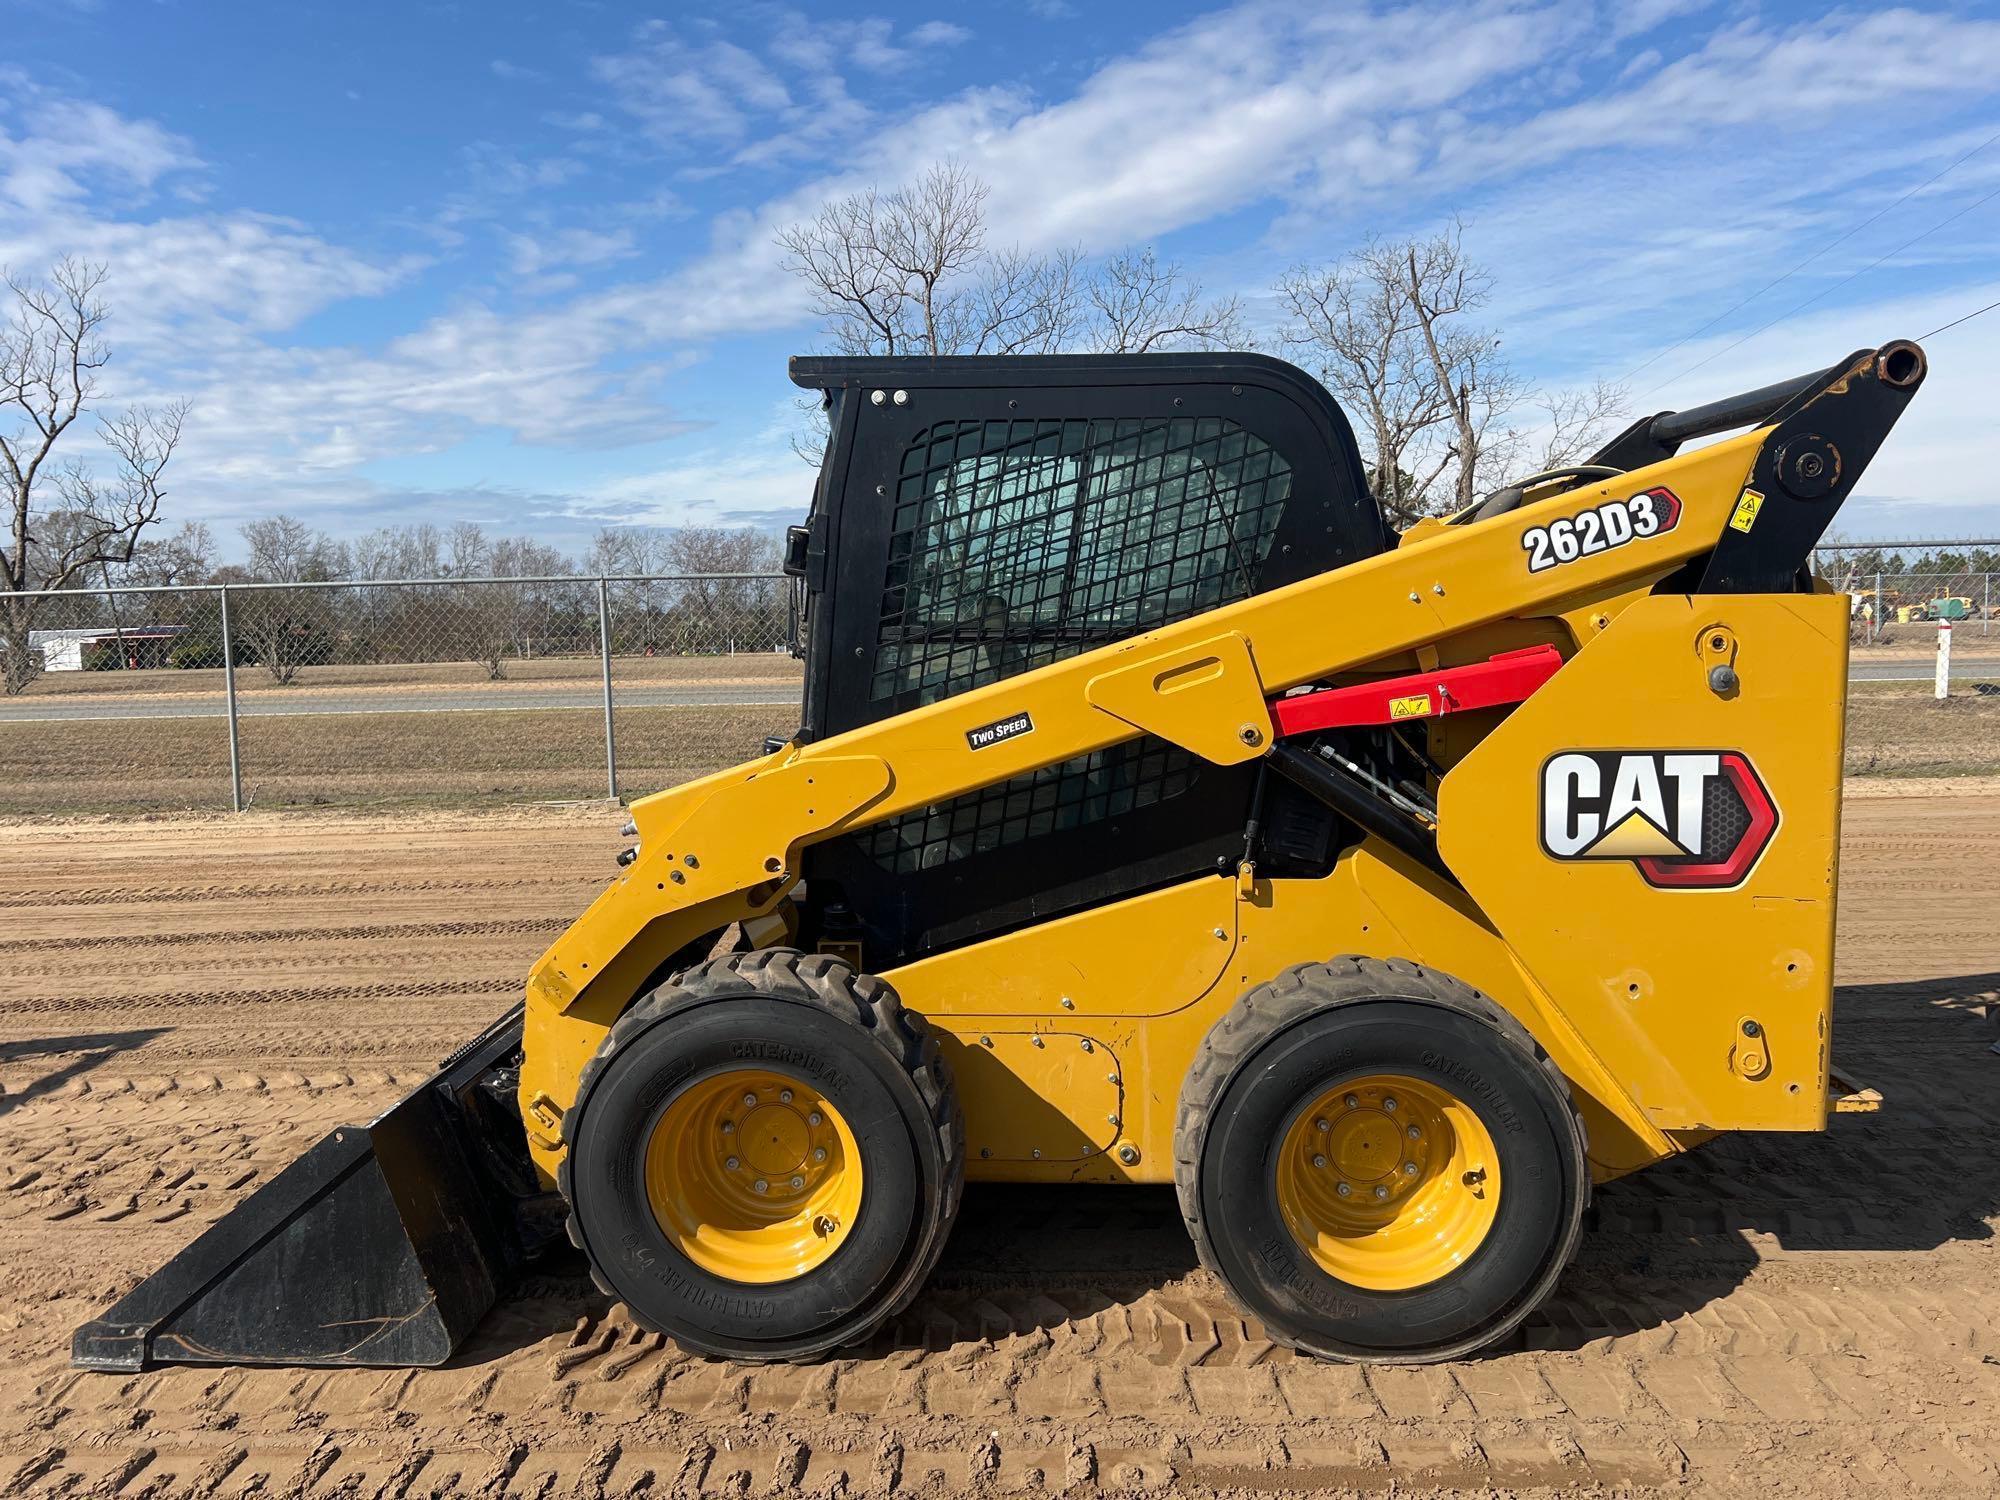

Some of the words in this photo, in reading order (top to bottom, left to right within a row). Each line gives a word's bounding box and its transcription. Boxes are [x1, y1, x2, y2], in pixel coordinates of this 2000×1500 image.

[1523, 494, 1659, 571] 262D3
[971, 730, 994, 746] TWO
[996, 718, 1027, 737] SPEED
[1545, 754, 1719, 856] CAT
[729, 1039, 848, 1092] CATERPILLAR
[1419, 1048, 1527, 1136] CATERPILLAR
[655, 1264, 776, 1321] CATERPILLAR
